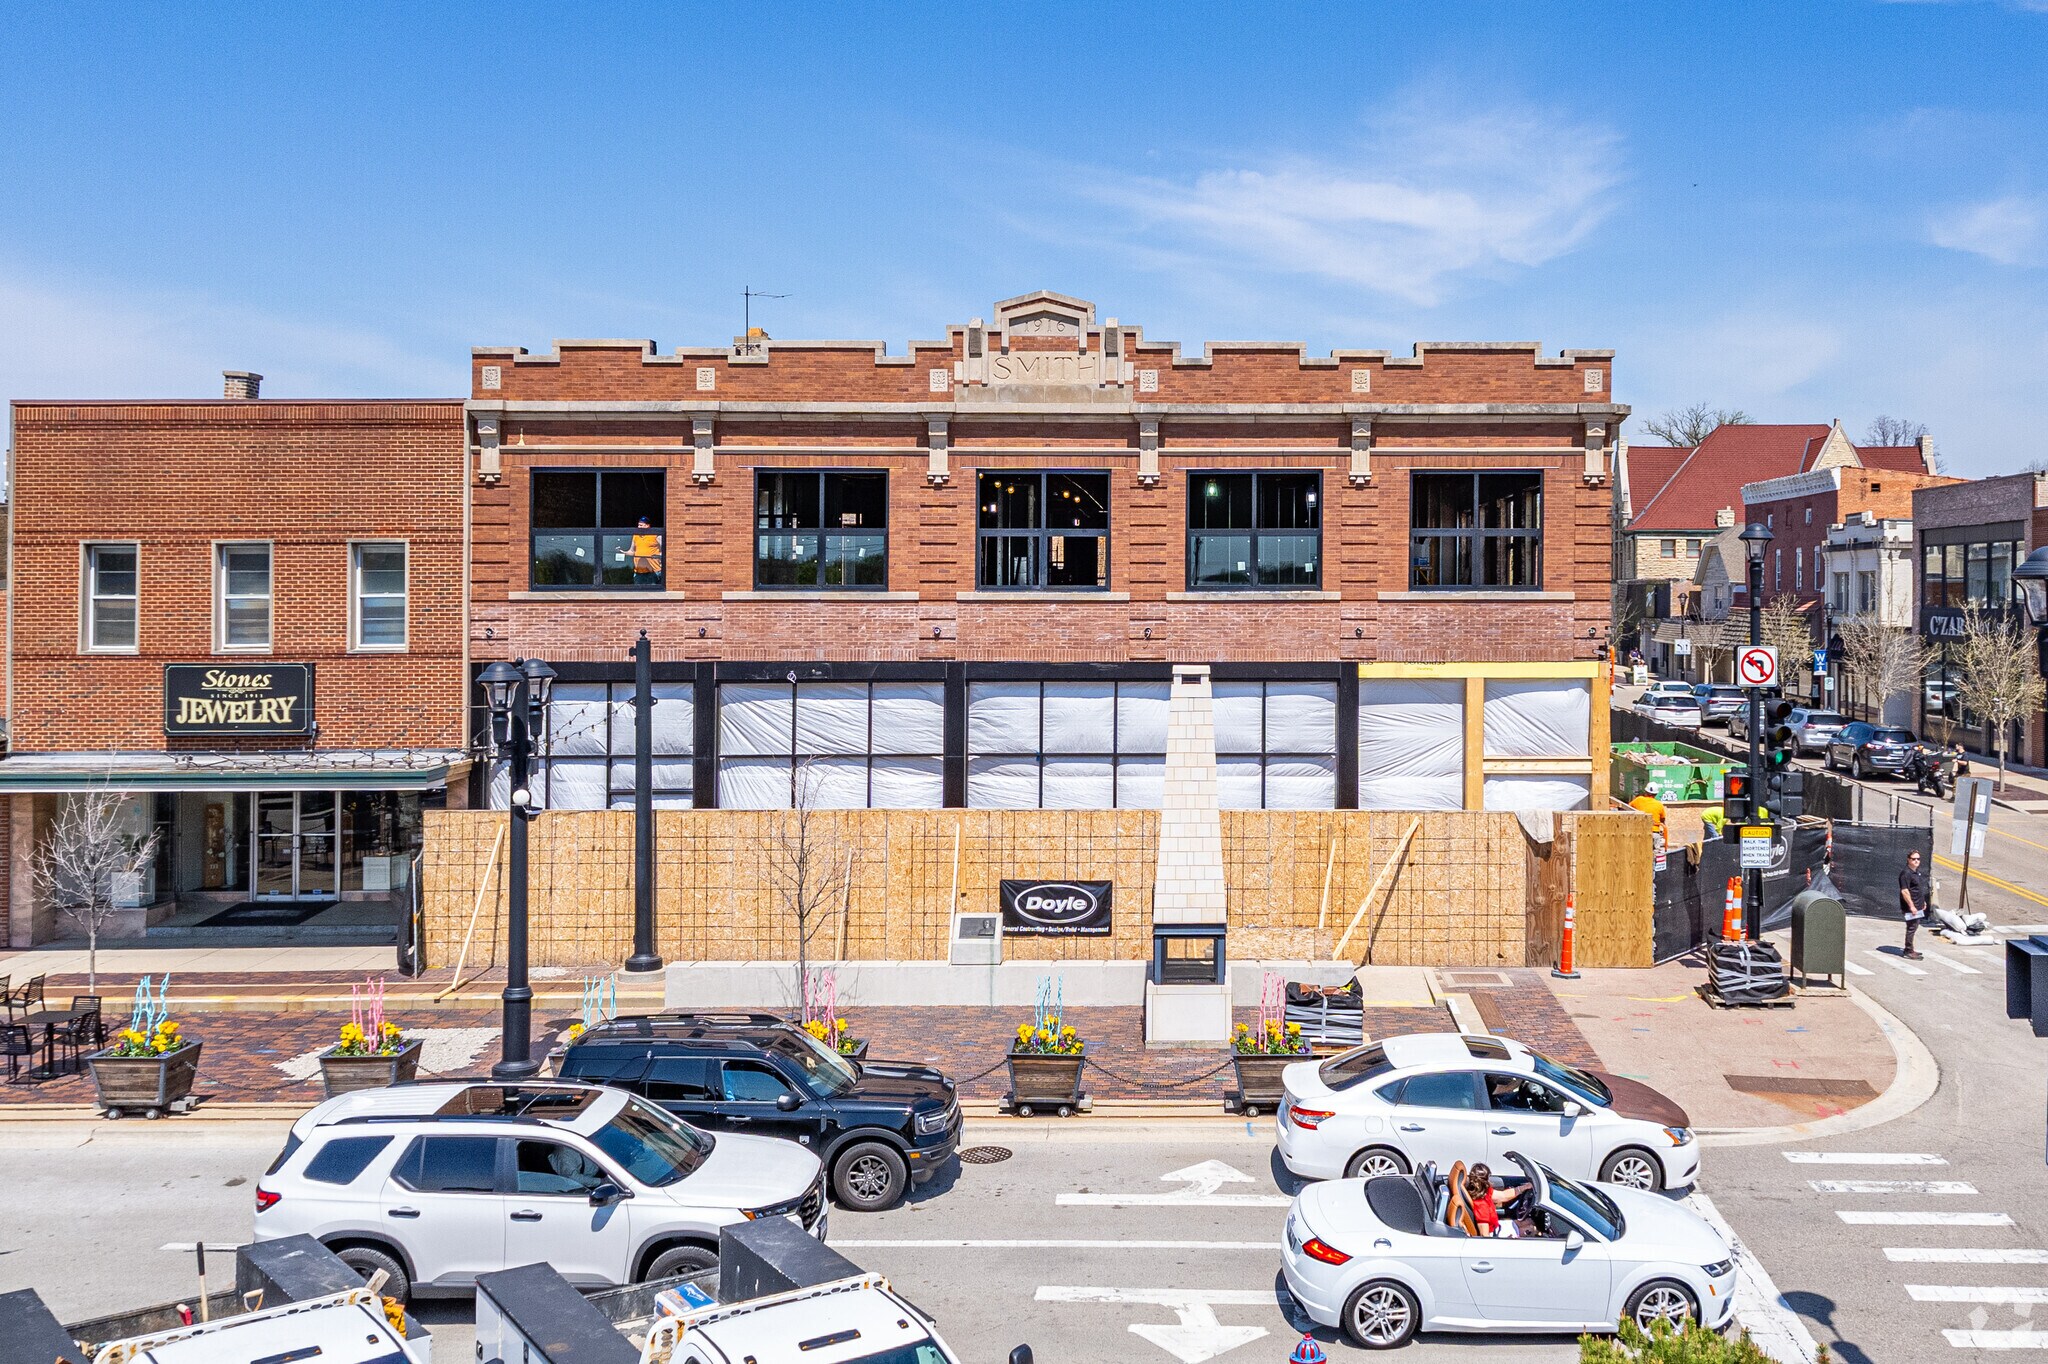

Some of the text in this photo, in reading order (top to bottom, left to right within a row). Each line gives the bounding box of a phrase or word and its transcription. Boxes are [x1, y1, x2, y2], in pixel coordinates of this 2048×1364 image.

[1024, 320, 1066, 332] 1916
[993, 357, 1097, 379] SMITH
[201, 669, 273, 688] Stones
[176, 696, 298, 724] JEWELRY
[1771, 844, 1785, 859] yle
[1026, 897, 1087, 913] Doyle
